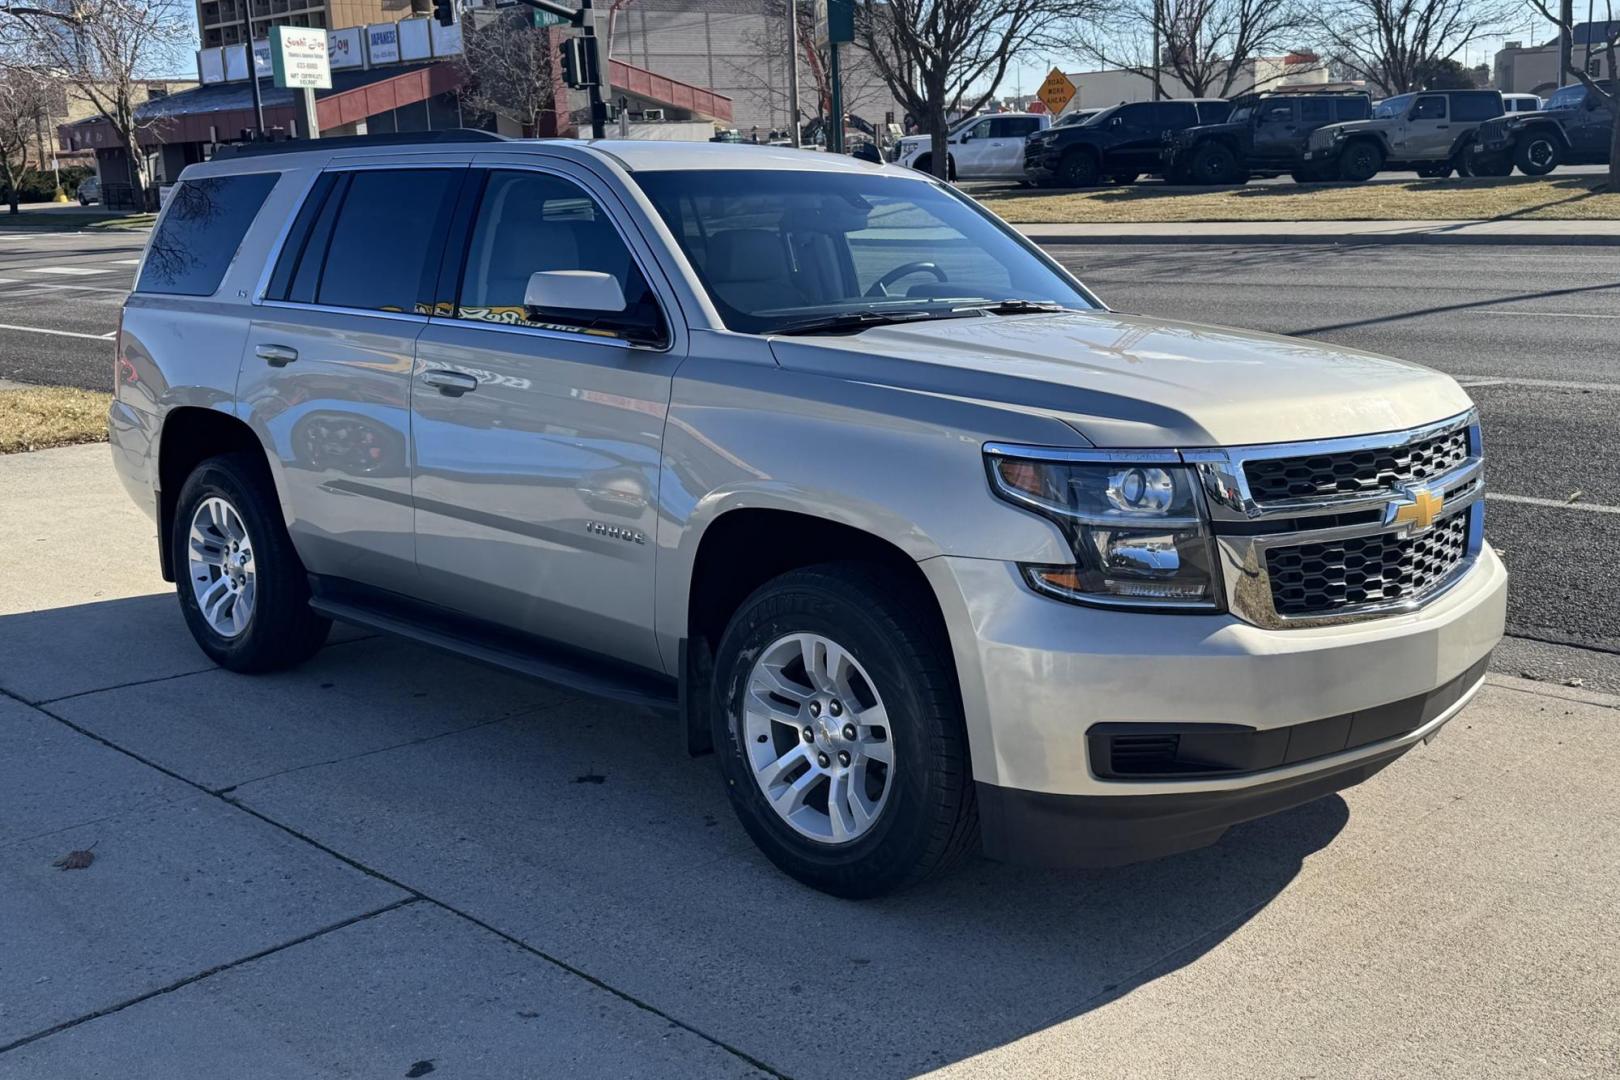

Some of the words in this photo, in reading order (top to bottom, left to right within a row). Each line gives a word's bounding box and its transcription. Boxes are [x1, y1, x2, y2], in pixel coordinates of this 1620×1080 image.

[543, 11, 559, 24] MAIN
[285, 36, 307, 49] Sushi
[308, 38, 325, 51] Joy
[371, 31, 396, 47] JAPANESE
[1047, 96, 1067, 104] AHEAD
[585, 520, 645, 545] TAHOE
